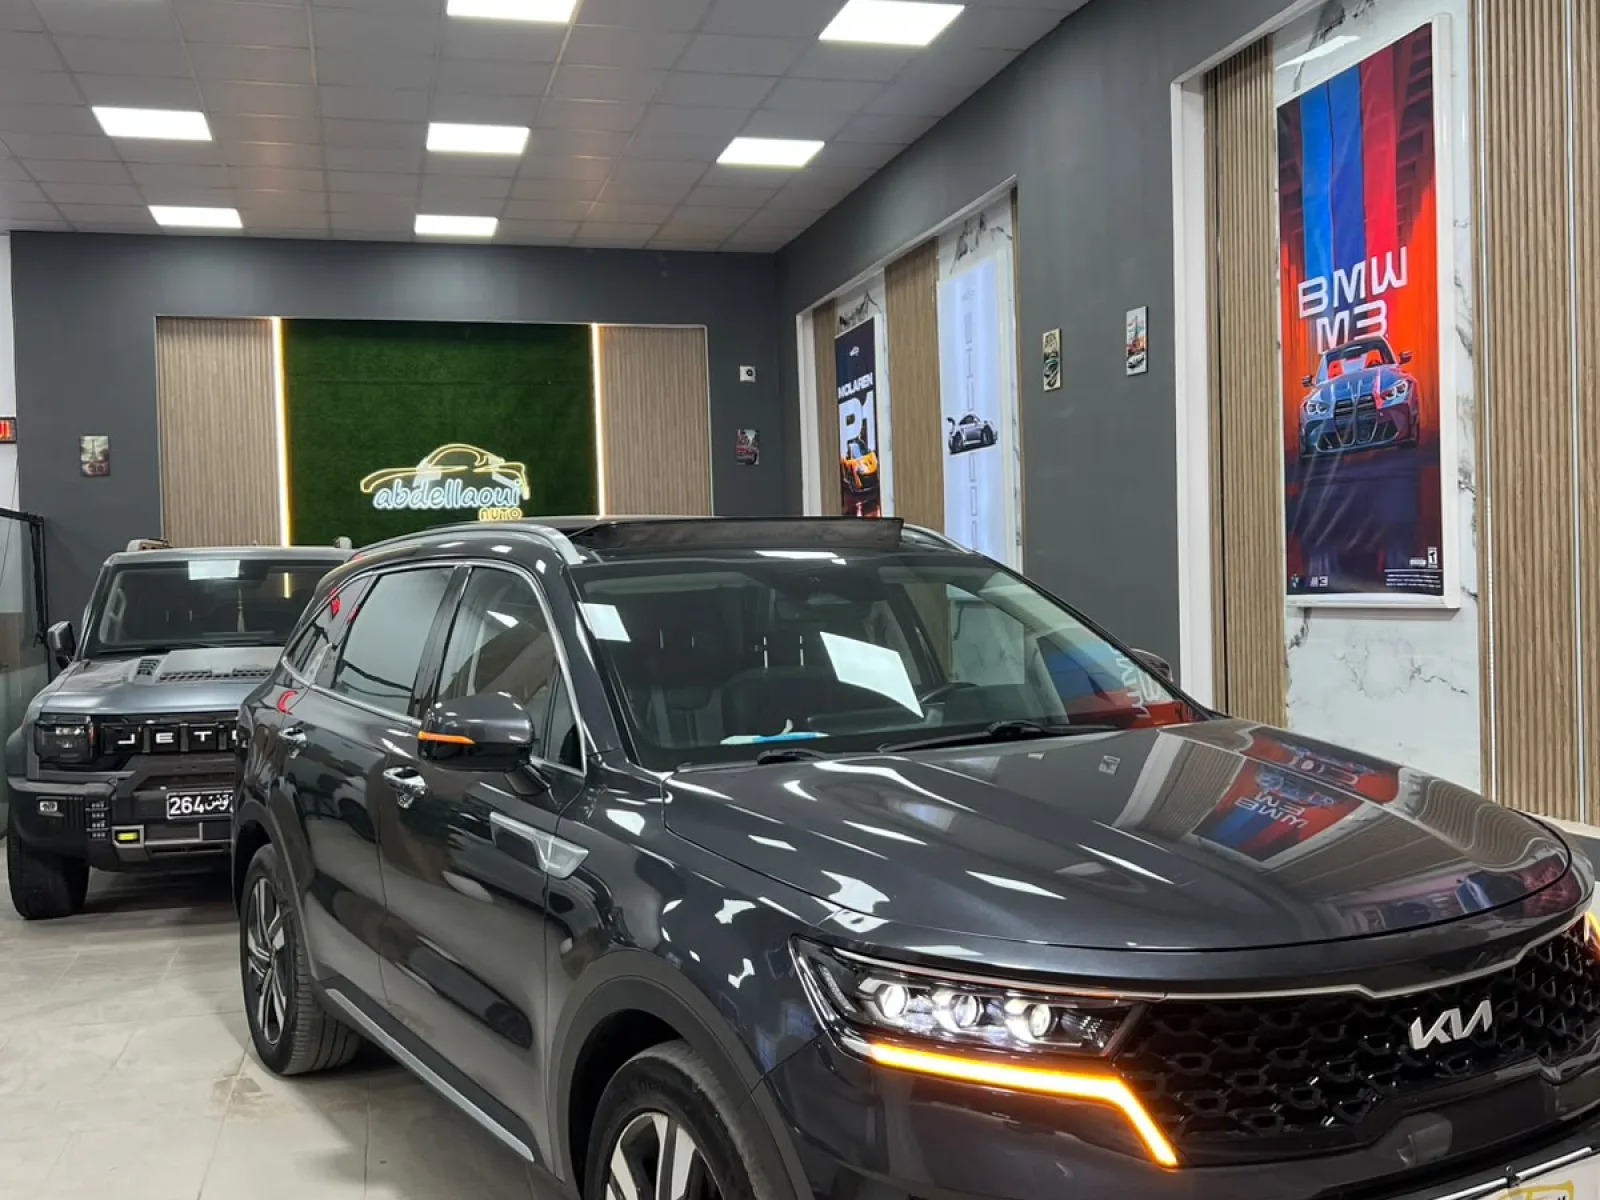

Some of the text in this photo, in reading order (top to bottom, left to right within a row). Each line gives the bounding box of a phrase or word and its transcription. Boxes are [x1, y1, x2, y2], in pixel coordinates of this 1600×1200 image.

[1298, 246, 1408, 319] BMW
[1316, 300, 1389, 354] M3
[839, 390, 876, 460] P1
[373, 478, 522, 510] abdellaoui
[169, 795, 205, 815] 264
[204, 794, 229, 811] تونس
[1409, 999, 1493, 1050] KIA
